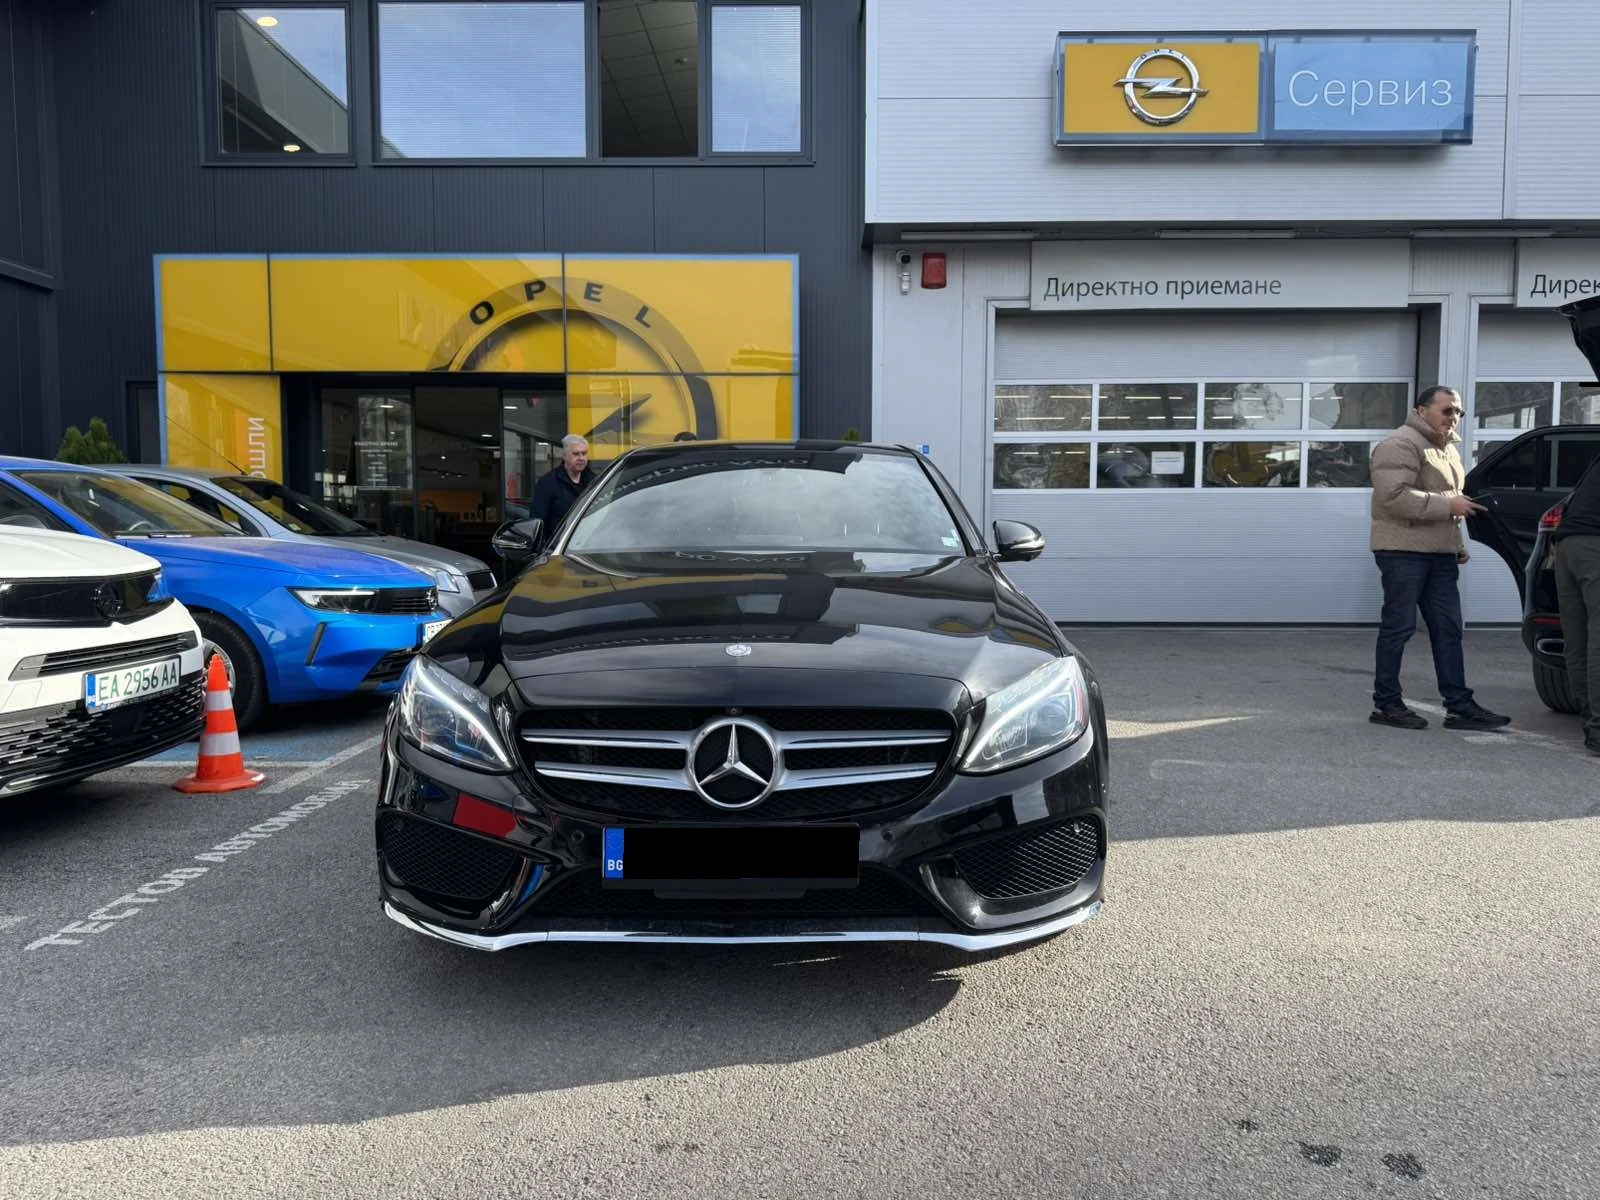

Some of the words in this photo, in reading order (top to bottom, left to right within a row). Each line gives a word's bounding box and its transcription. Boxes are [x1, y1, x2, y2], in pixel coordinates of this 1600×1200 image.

[1289, 70, 1452, 116] Сервиз
[469, 279, 652, 329] OPEL
[1043, 277, 1159, 301] Директно
[1166, 279, 1282, 300] приемане
[98, 674, 120, 700] EA
[123, 666, 159, 695] 2956
[161, 662, 178, 687] AA
[607, 859, 624, 871] BG
[24, 867, 210, 951] ТЕСТОВ
